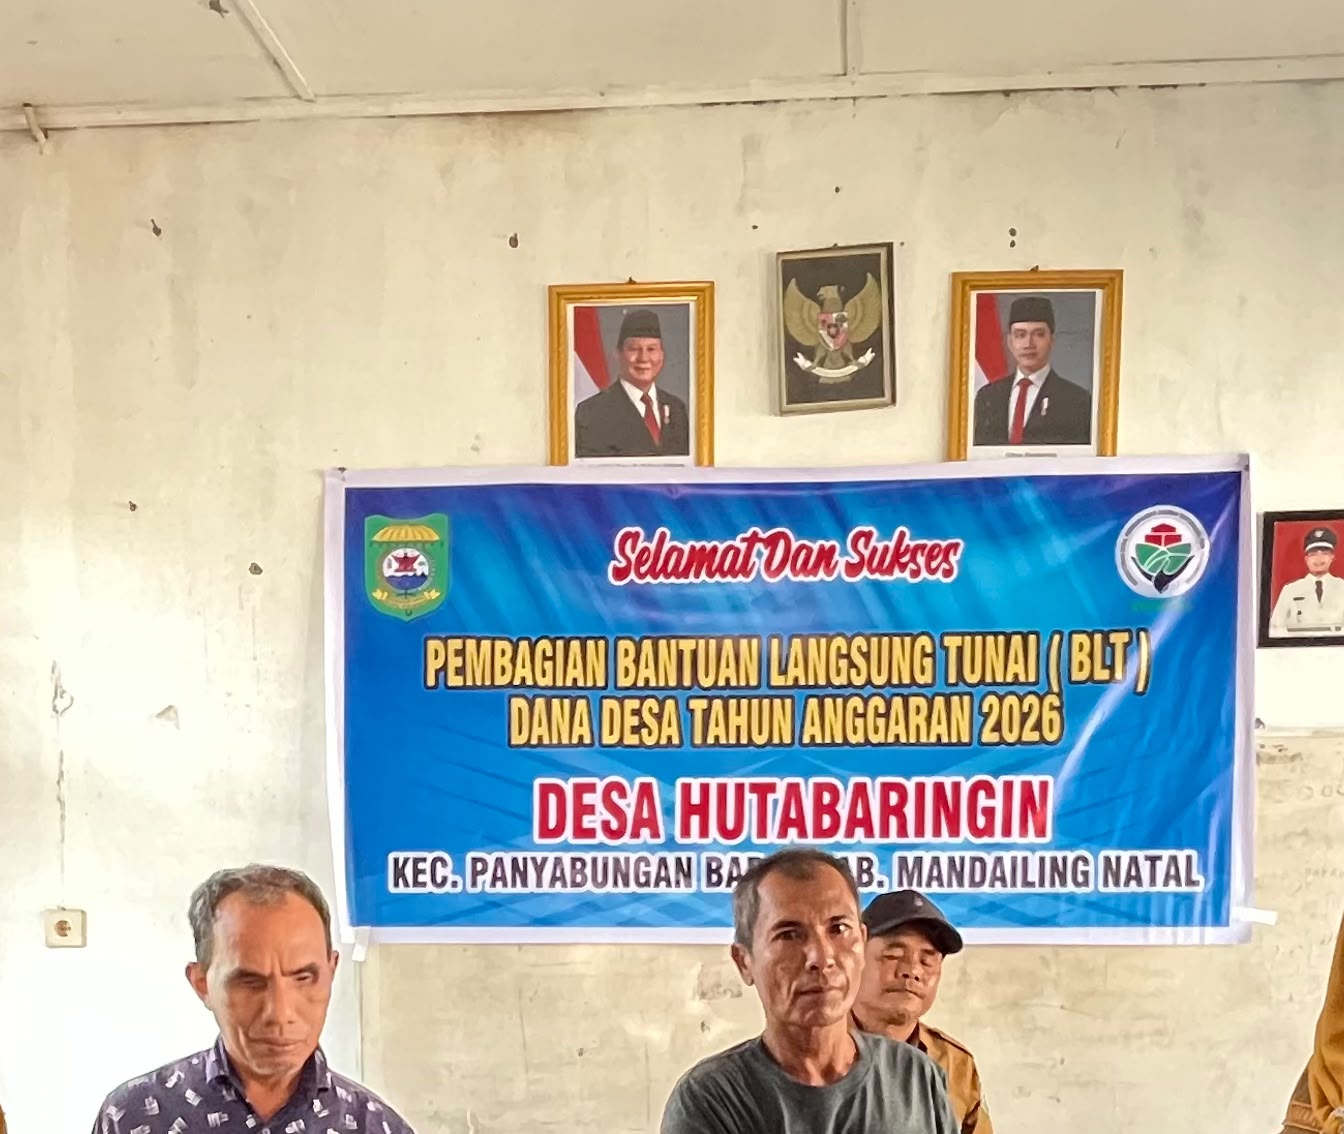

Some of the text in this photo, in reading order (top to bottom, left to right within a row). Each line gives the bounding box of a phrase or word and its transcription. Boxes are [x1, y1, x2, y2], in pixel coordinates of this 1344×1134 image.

[611, 528, 962, 581] Selamat Dan Sukses
[425, 637, 607, 688] PEMBAGIAN
[615, 637, 760, 688] BANTUAN
[769, 633, 935, 686] LANGSUNG
[942, 632, 1038, 685] TUNAI
[1070, 631, 1130, 683] BLT
[509, 693, 1063, 746] DANA DESA TAHUN ANGGARAN 2026
[538, 778, 1050, 841] DESA HUTABARINGIN
[392, 856, 458, 889] KEC.
[469, 856, 694, 889] PANYABUNGAN
[705, 856, 765, 889] BA
[897, 854, 1090, 889] MANDAILING
[1103, 854, 1200, 888] NATAL
